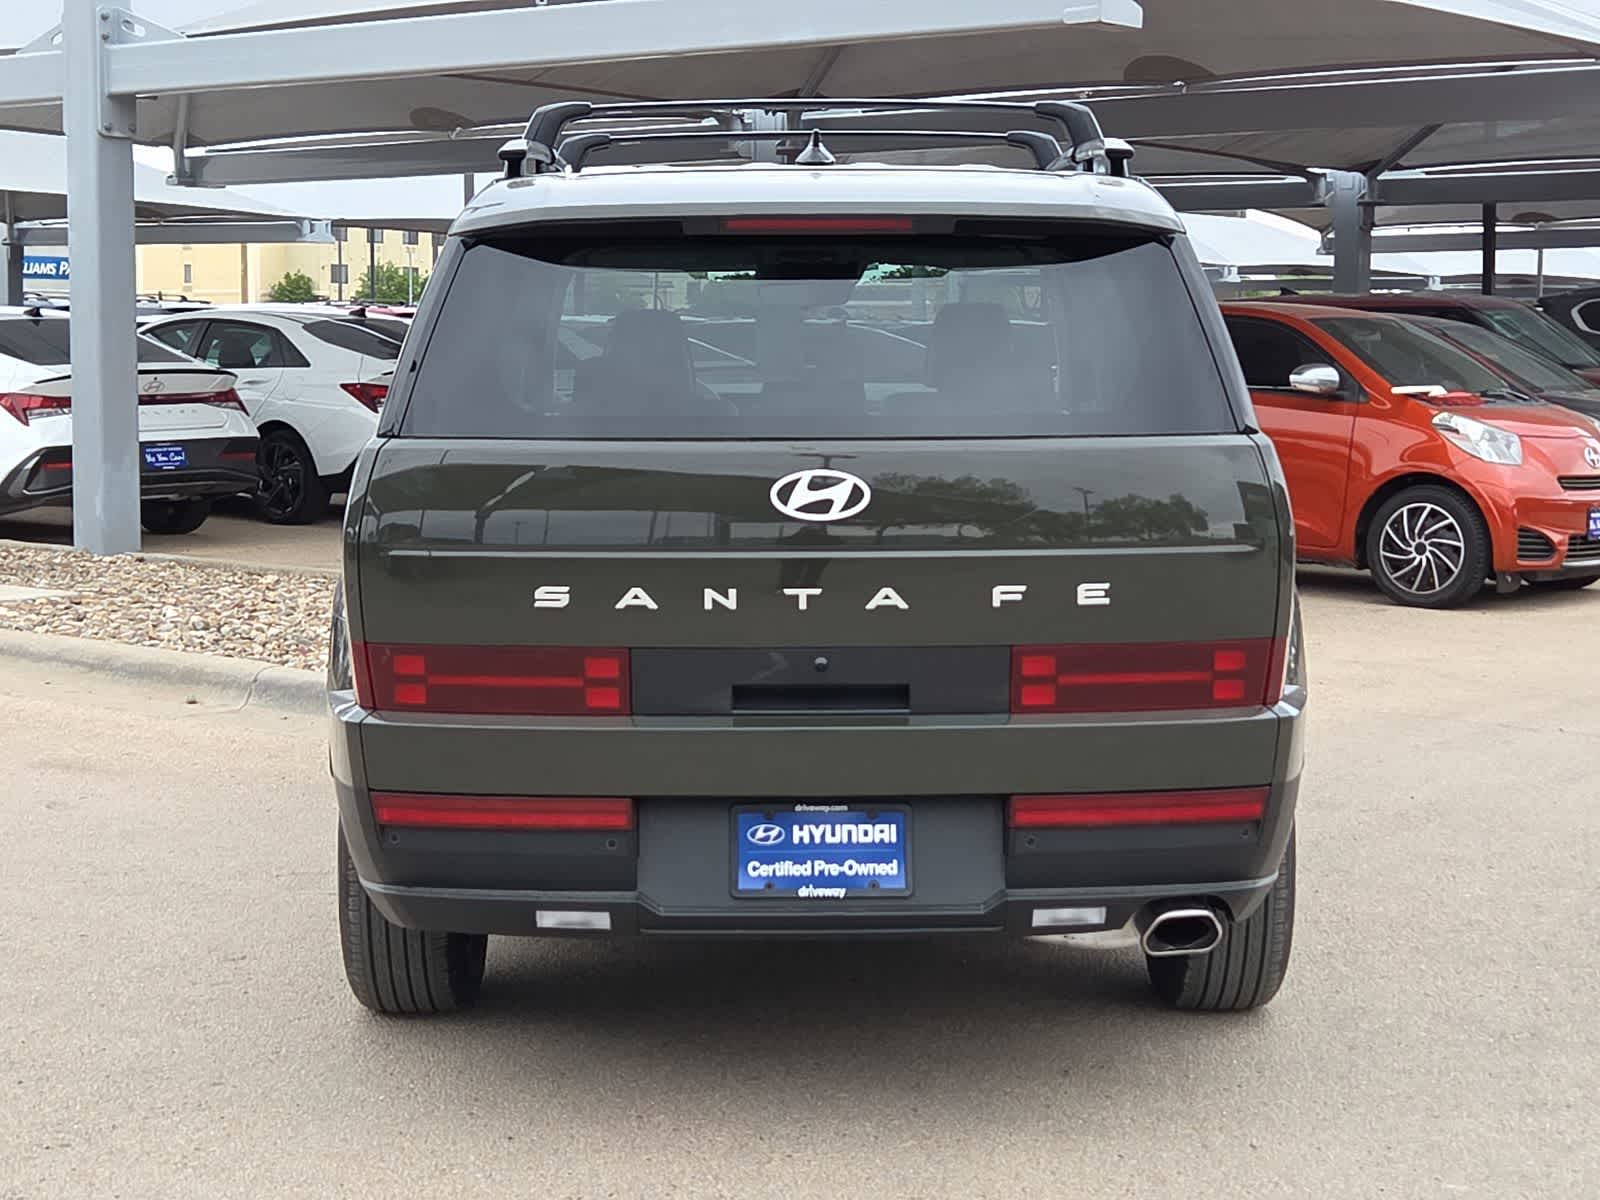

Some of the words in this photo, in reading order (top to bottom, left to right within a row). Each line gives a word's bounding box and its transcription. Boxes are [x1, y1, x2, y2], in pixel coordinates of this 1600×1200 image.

[533, 585, 910, 611] SANTA
[991, 582, 1111, 608] FE
[792, 823, 897, 845] HYUNDAI
[747, 860, 812, 878] Certified
[813, 858, 898, 877] Pre-Owned
[797, 884, 847, 899] driveway
